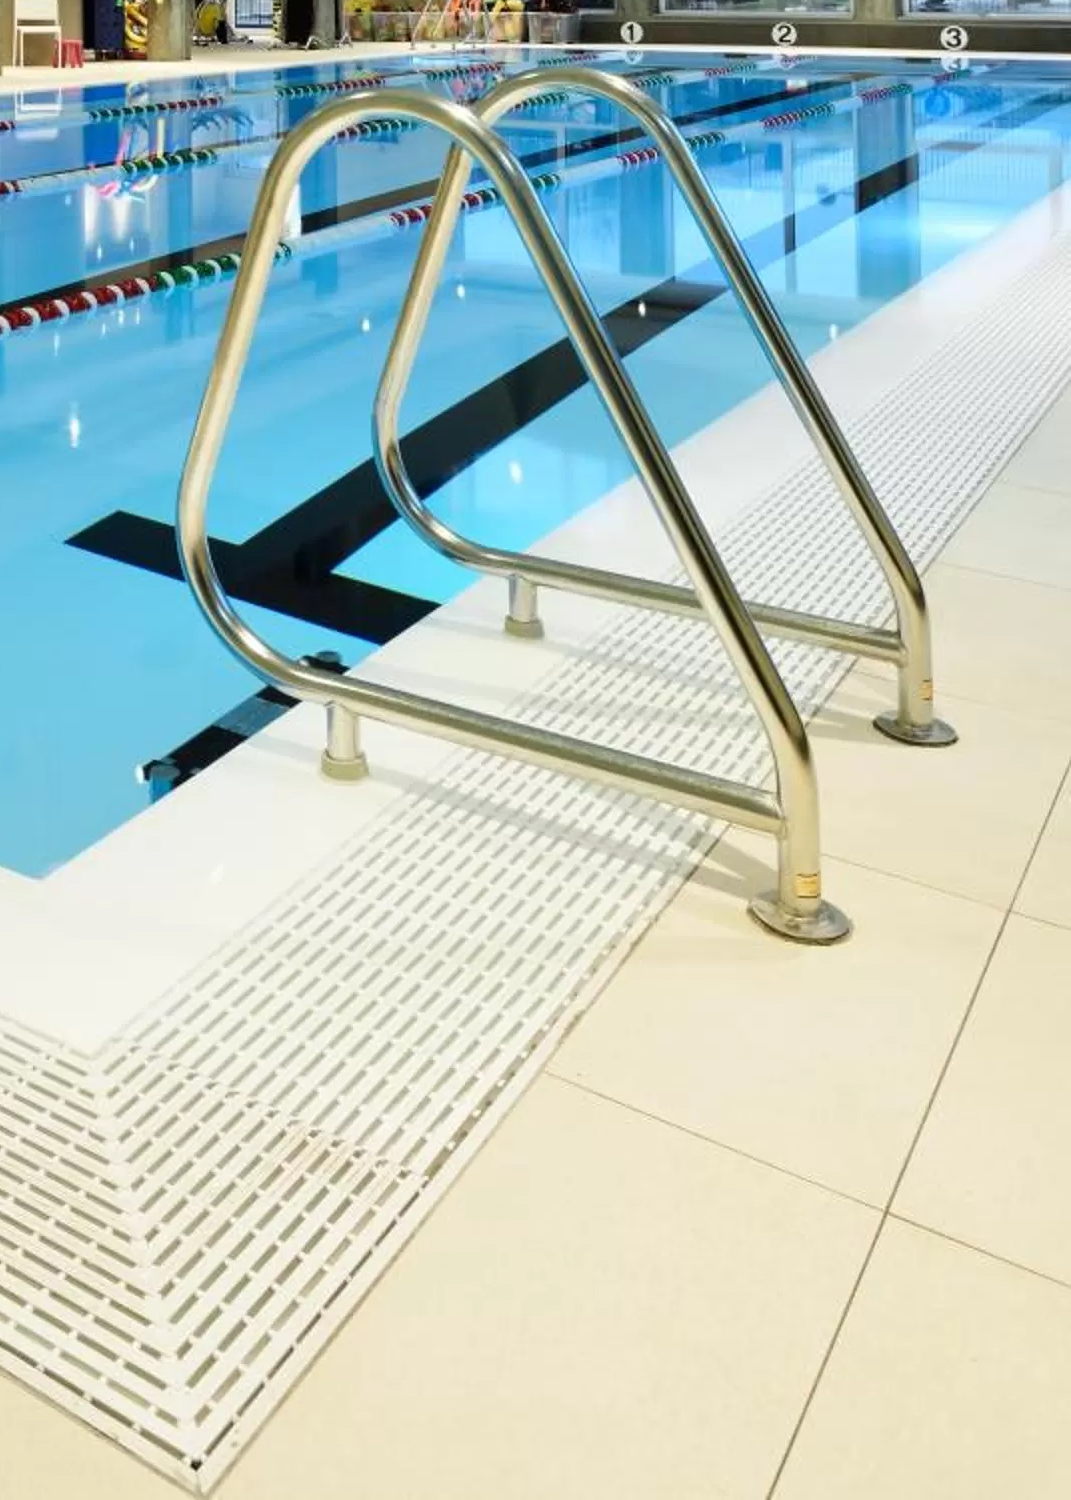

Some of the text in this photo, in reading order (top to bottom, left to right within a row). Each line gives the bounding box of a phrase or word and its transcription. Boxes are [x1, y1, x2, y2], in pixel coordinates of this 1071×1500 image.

[627, 23, 634, 41] 1
[778, 25, 791, 42] 2
[947, 28, 962, 48] 3
